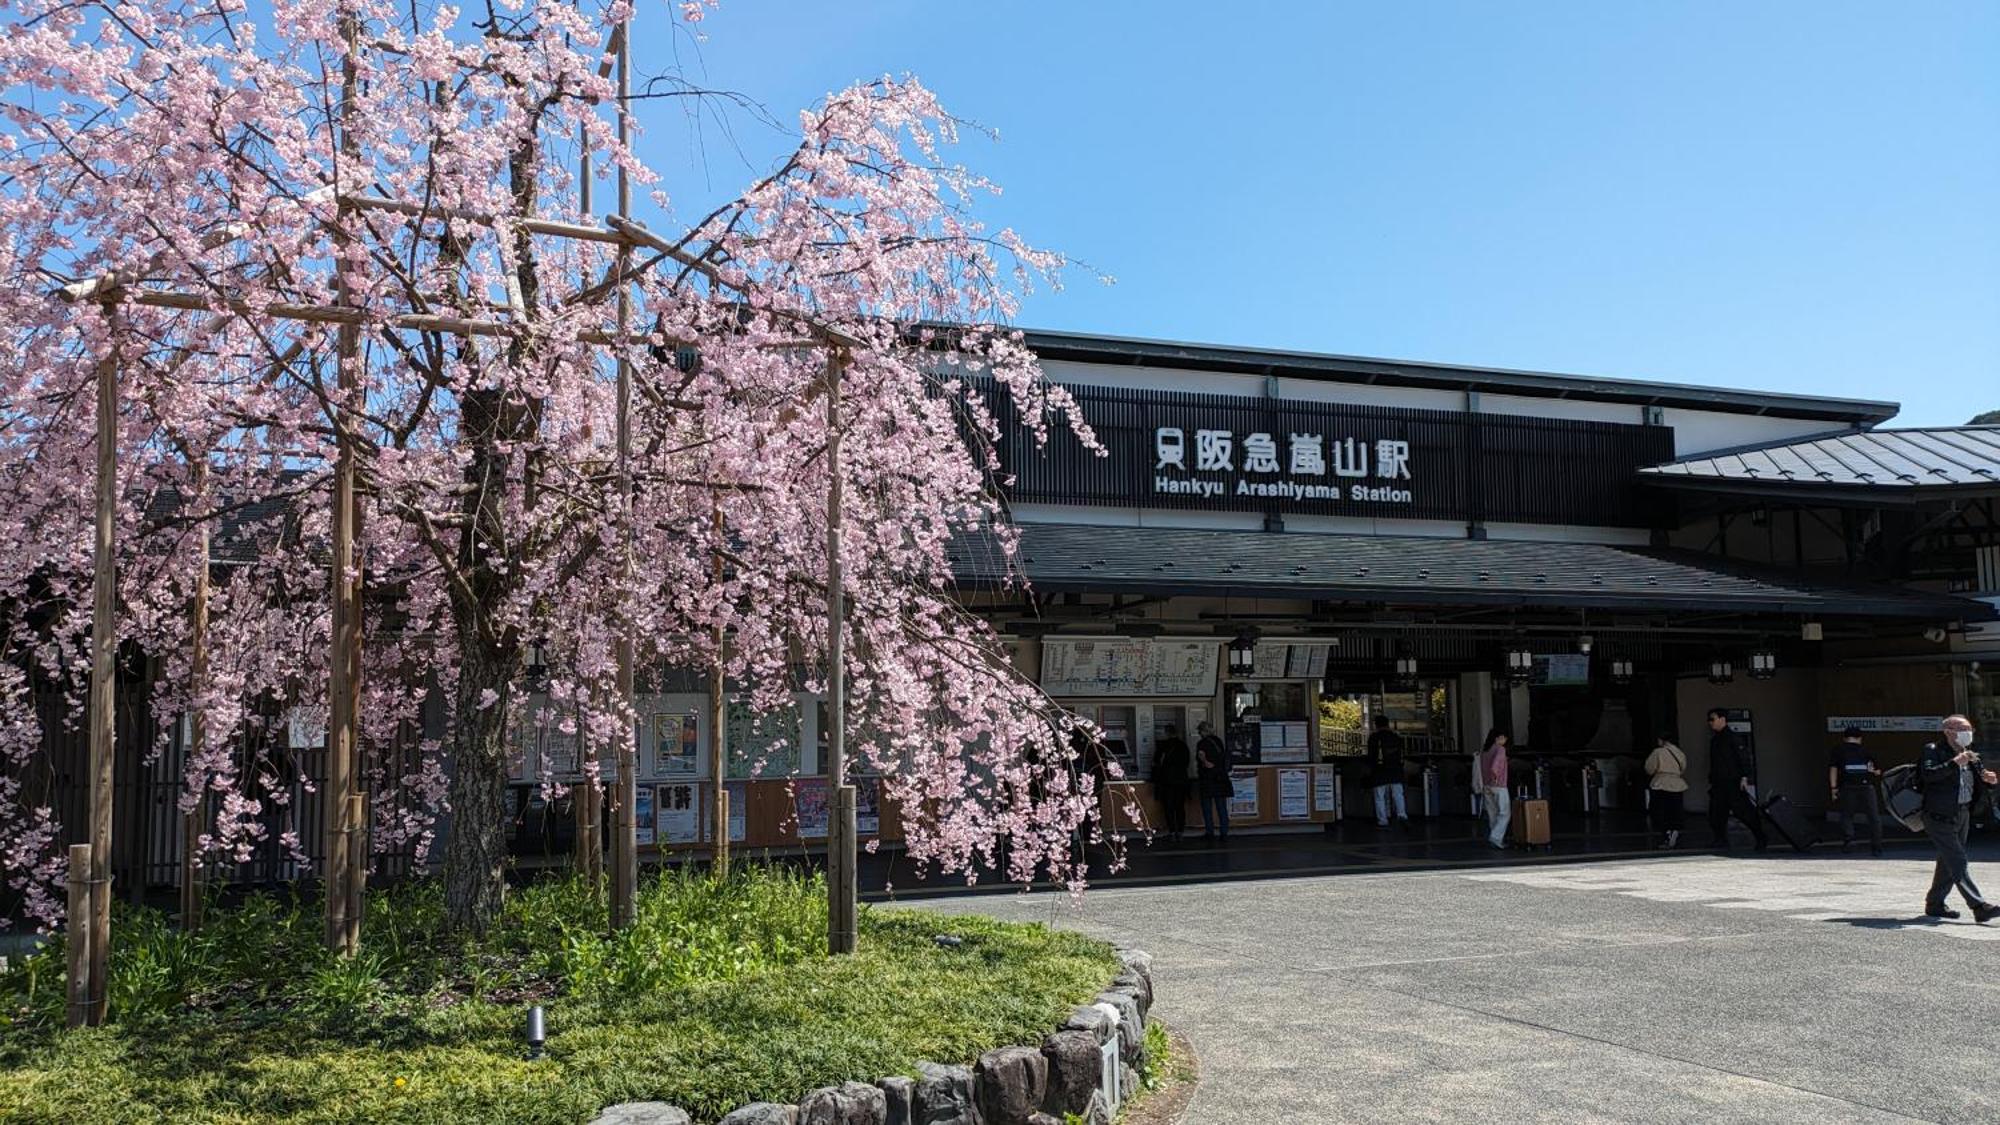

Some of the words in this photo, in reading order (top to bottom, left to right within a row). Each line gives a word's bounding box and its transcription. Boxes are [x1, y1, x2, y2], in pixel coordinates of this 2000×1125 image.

[1195, 429, 1411, 480] 阪急嵐山駅
[1155, 476, 1224, 498] Hankyu
[1237, 480, 1340, 500] Arashiyama
[1351, 485, 1412, 503] Station
